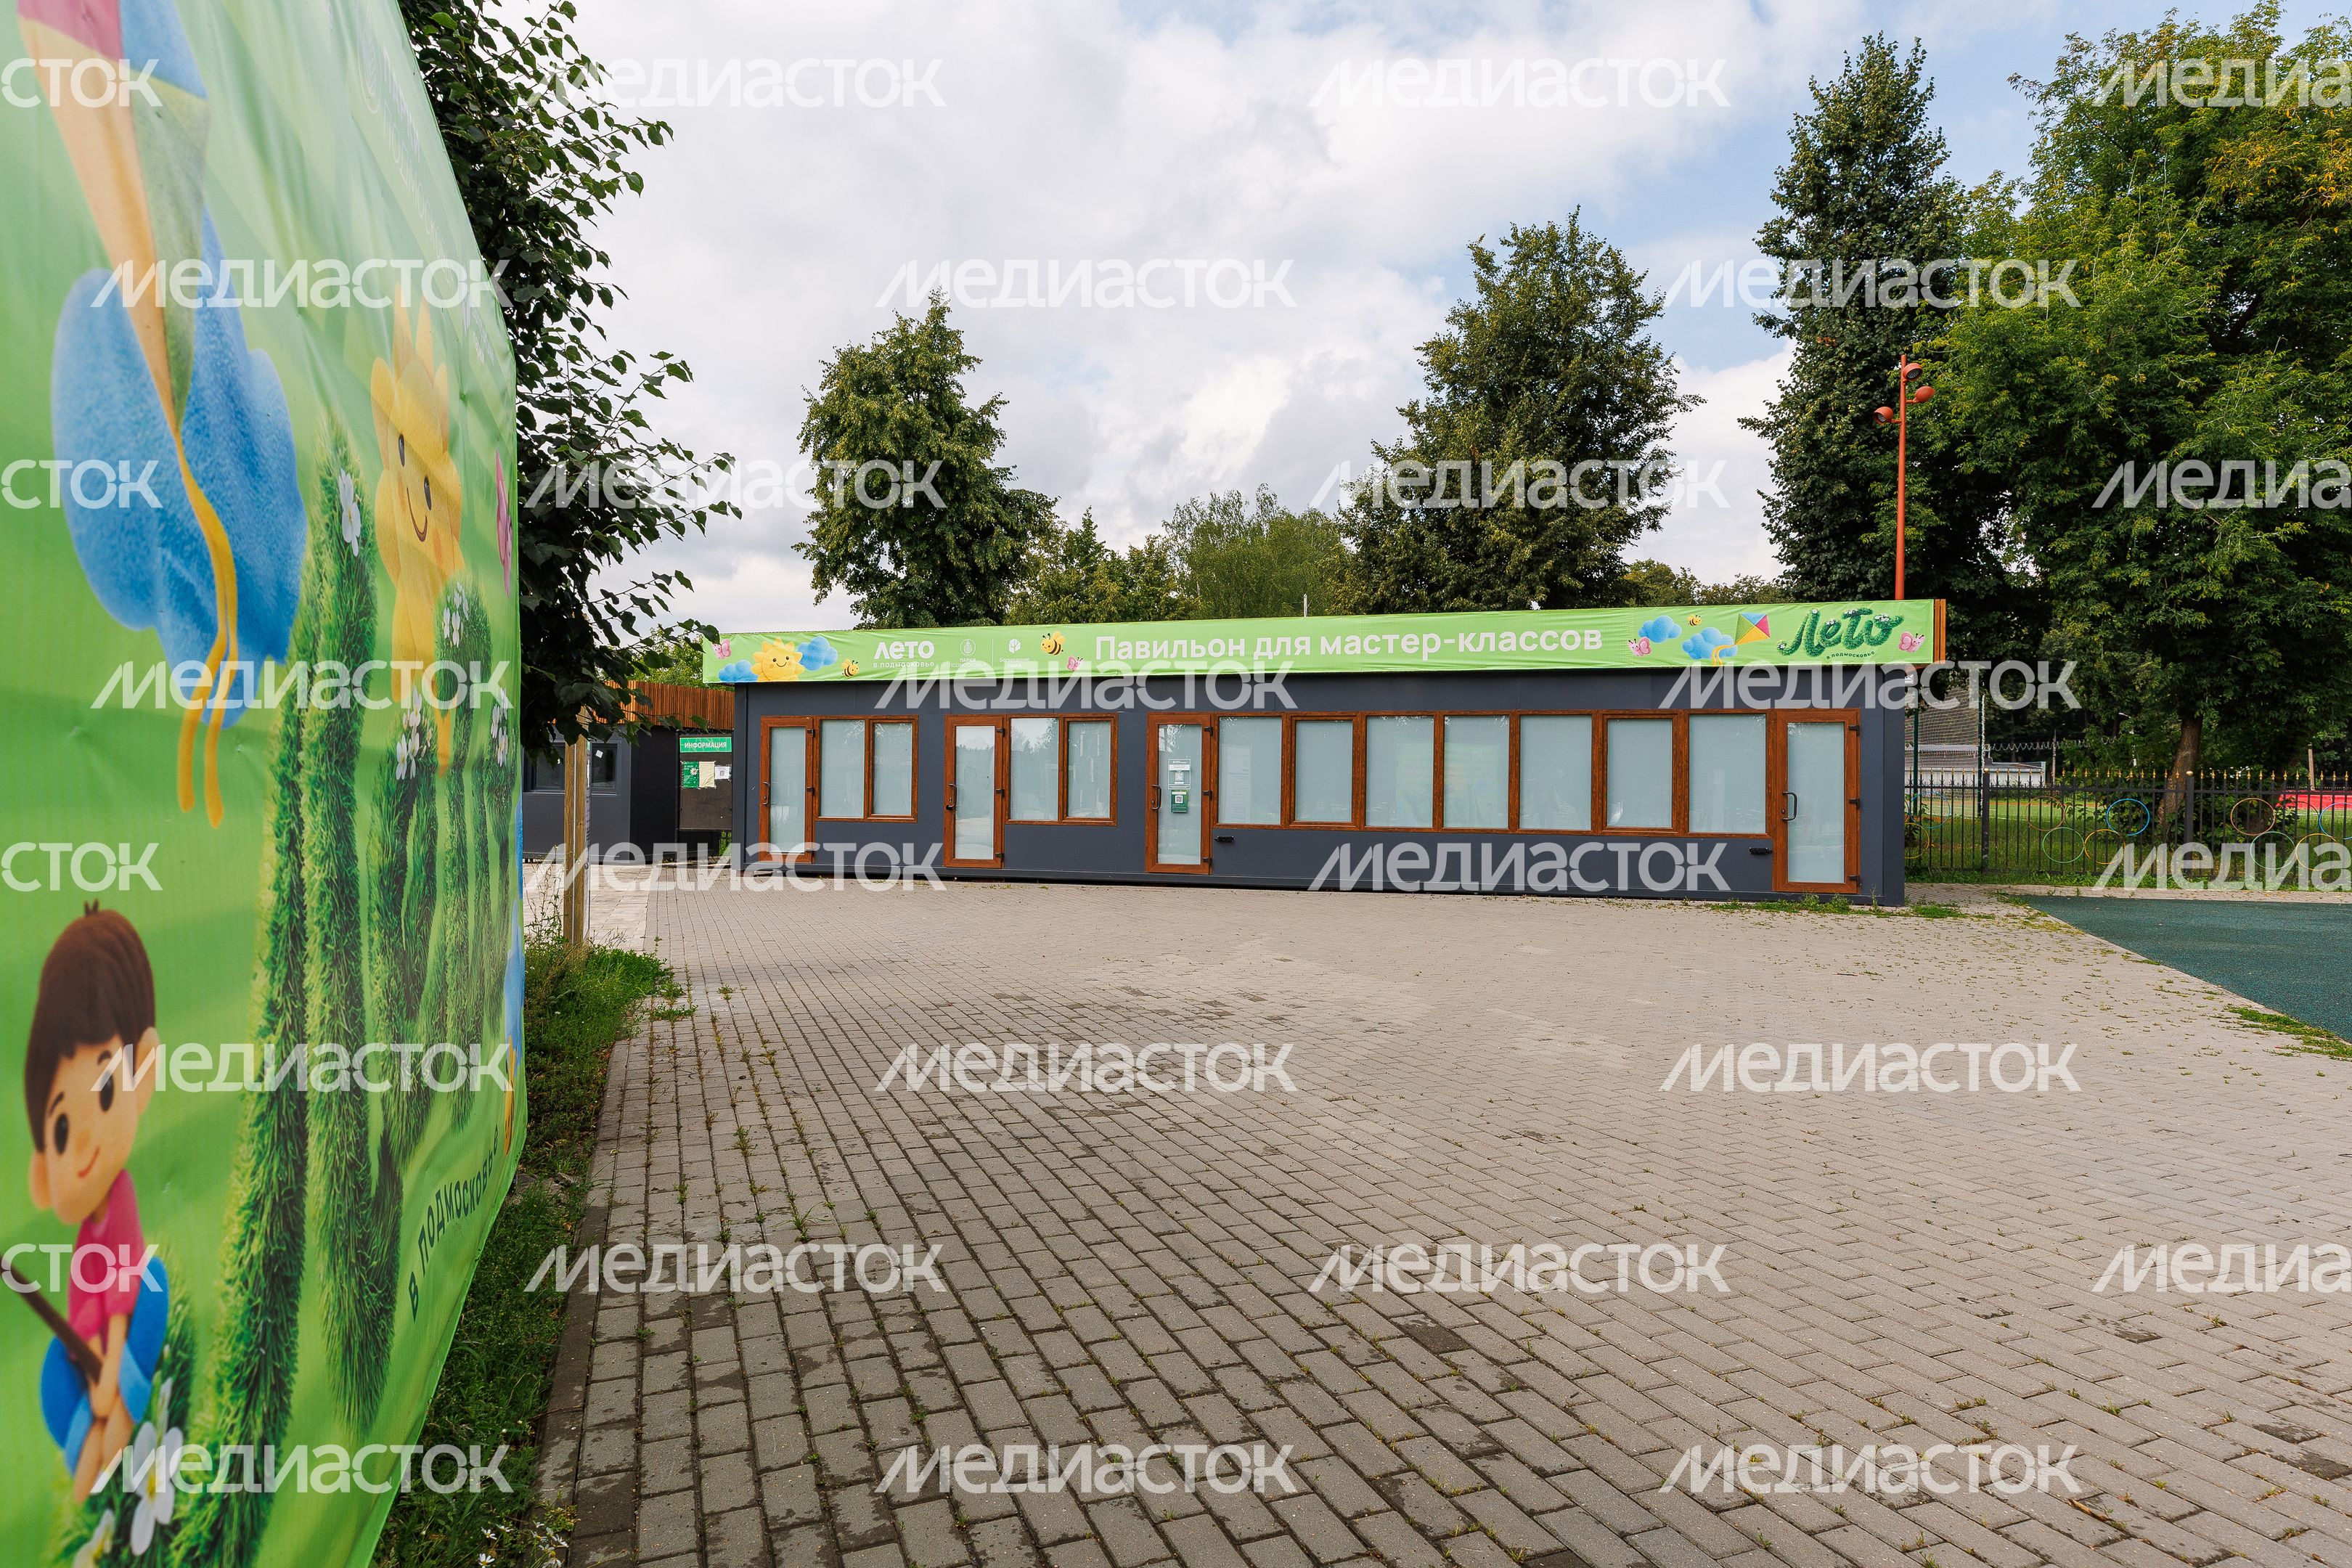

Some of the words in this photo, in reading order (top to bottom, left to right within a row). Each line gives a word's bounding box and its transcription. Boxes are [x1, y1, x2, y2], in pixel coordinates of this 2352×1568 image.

[1095, 635, 1246, 661] Павильон
[1253, 636, 1310, 661] для
[1320, 629, 1604, 661] мастер-классов
[418, 1124, 499, 1278] подмосковье
